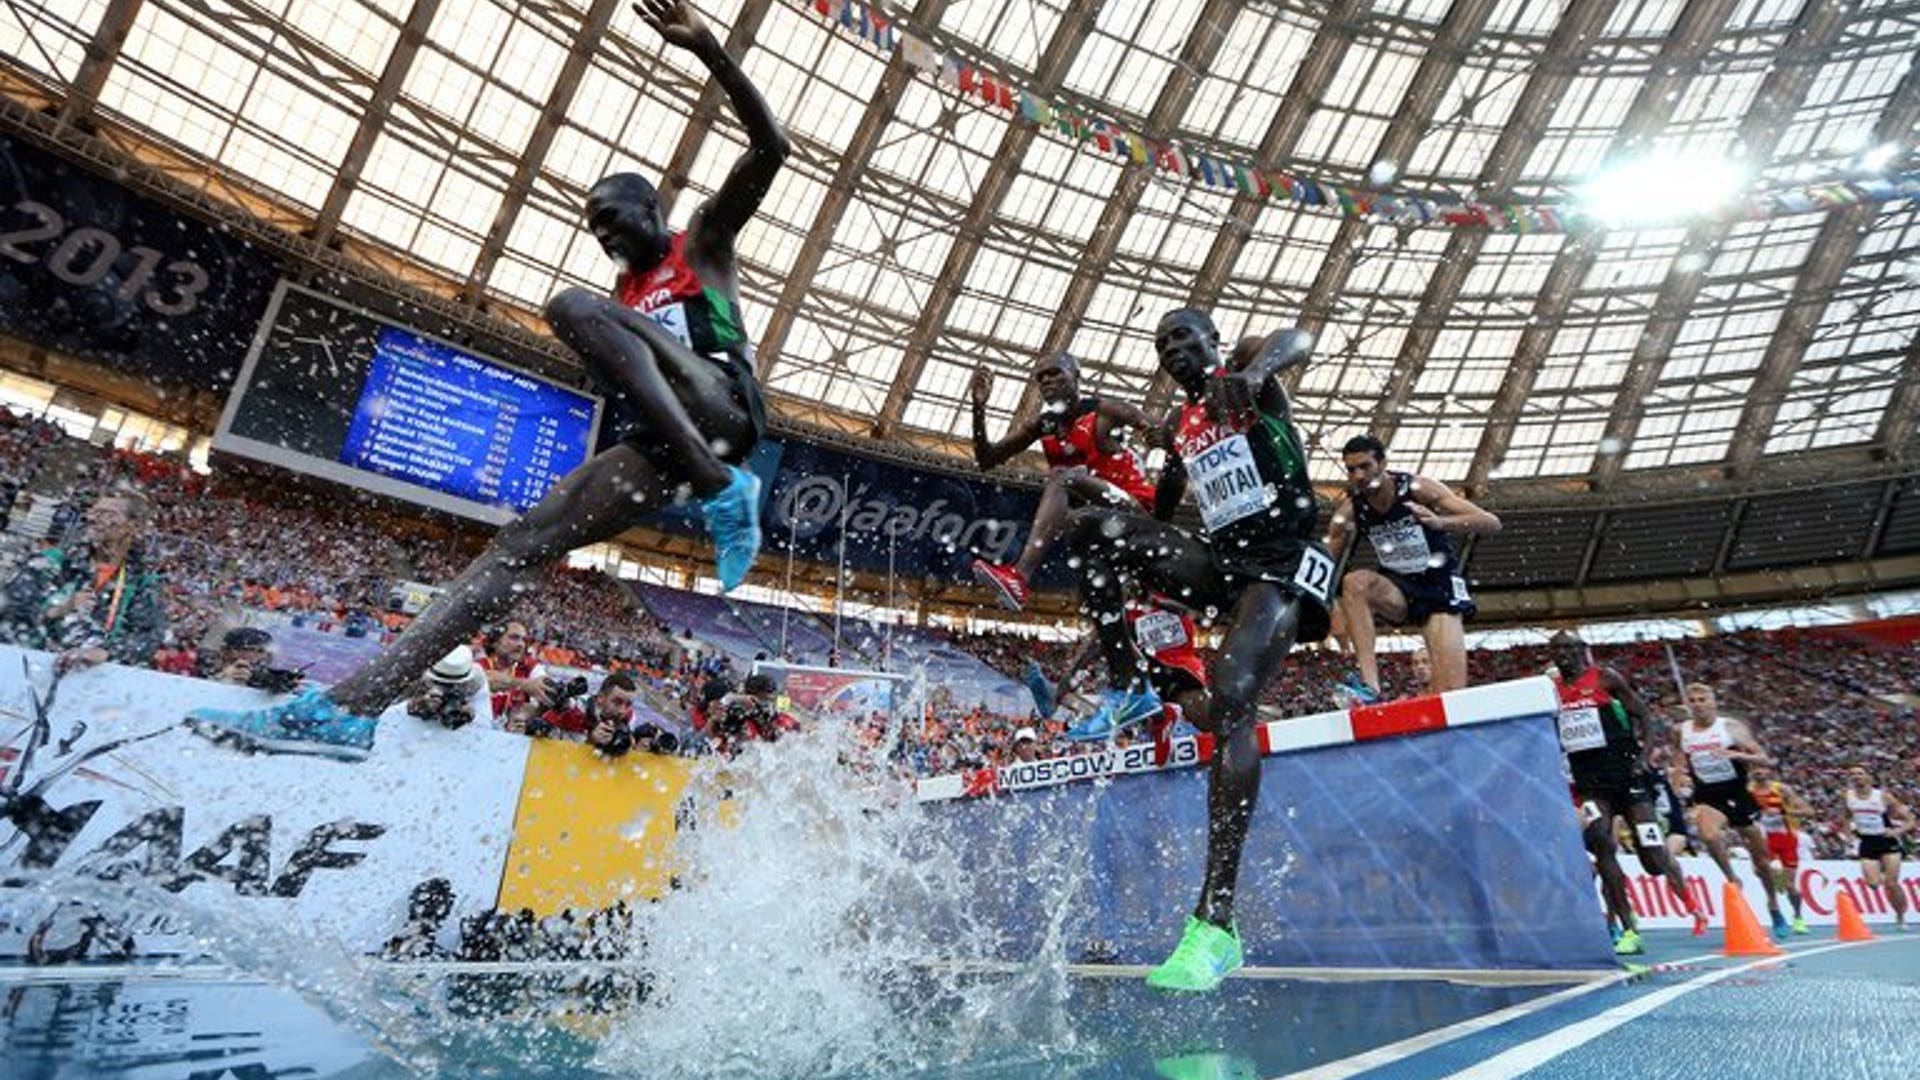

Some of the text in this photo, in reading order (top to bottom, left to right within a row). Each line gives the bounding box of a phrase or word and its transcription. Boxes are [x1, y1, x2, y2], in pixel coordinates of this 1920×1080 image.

[0, 199, 209, 316] 2013
[1195, 440, 1241, 473] TDK
[1204, 465, 1258, 507] MUTAI
[1304, 555, 1328, 593] 12
[1000, 752, 1115, 787] MOSCOW
